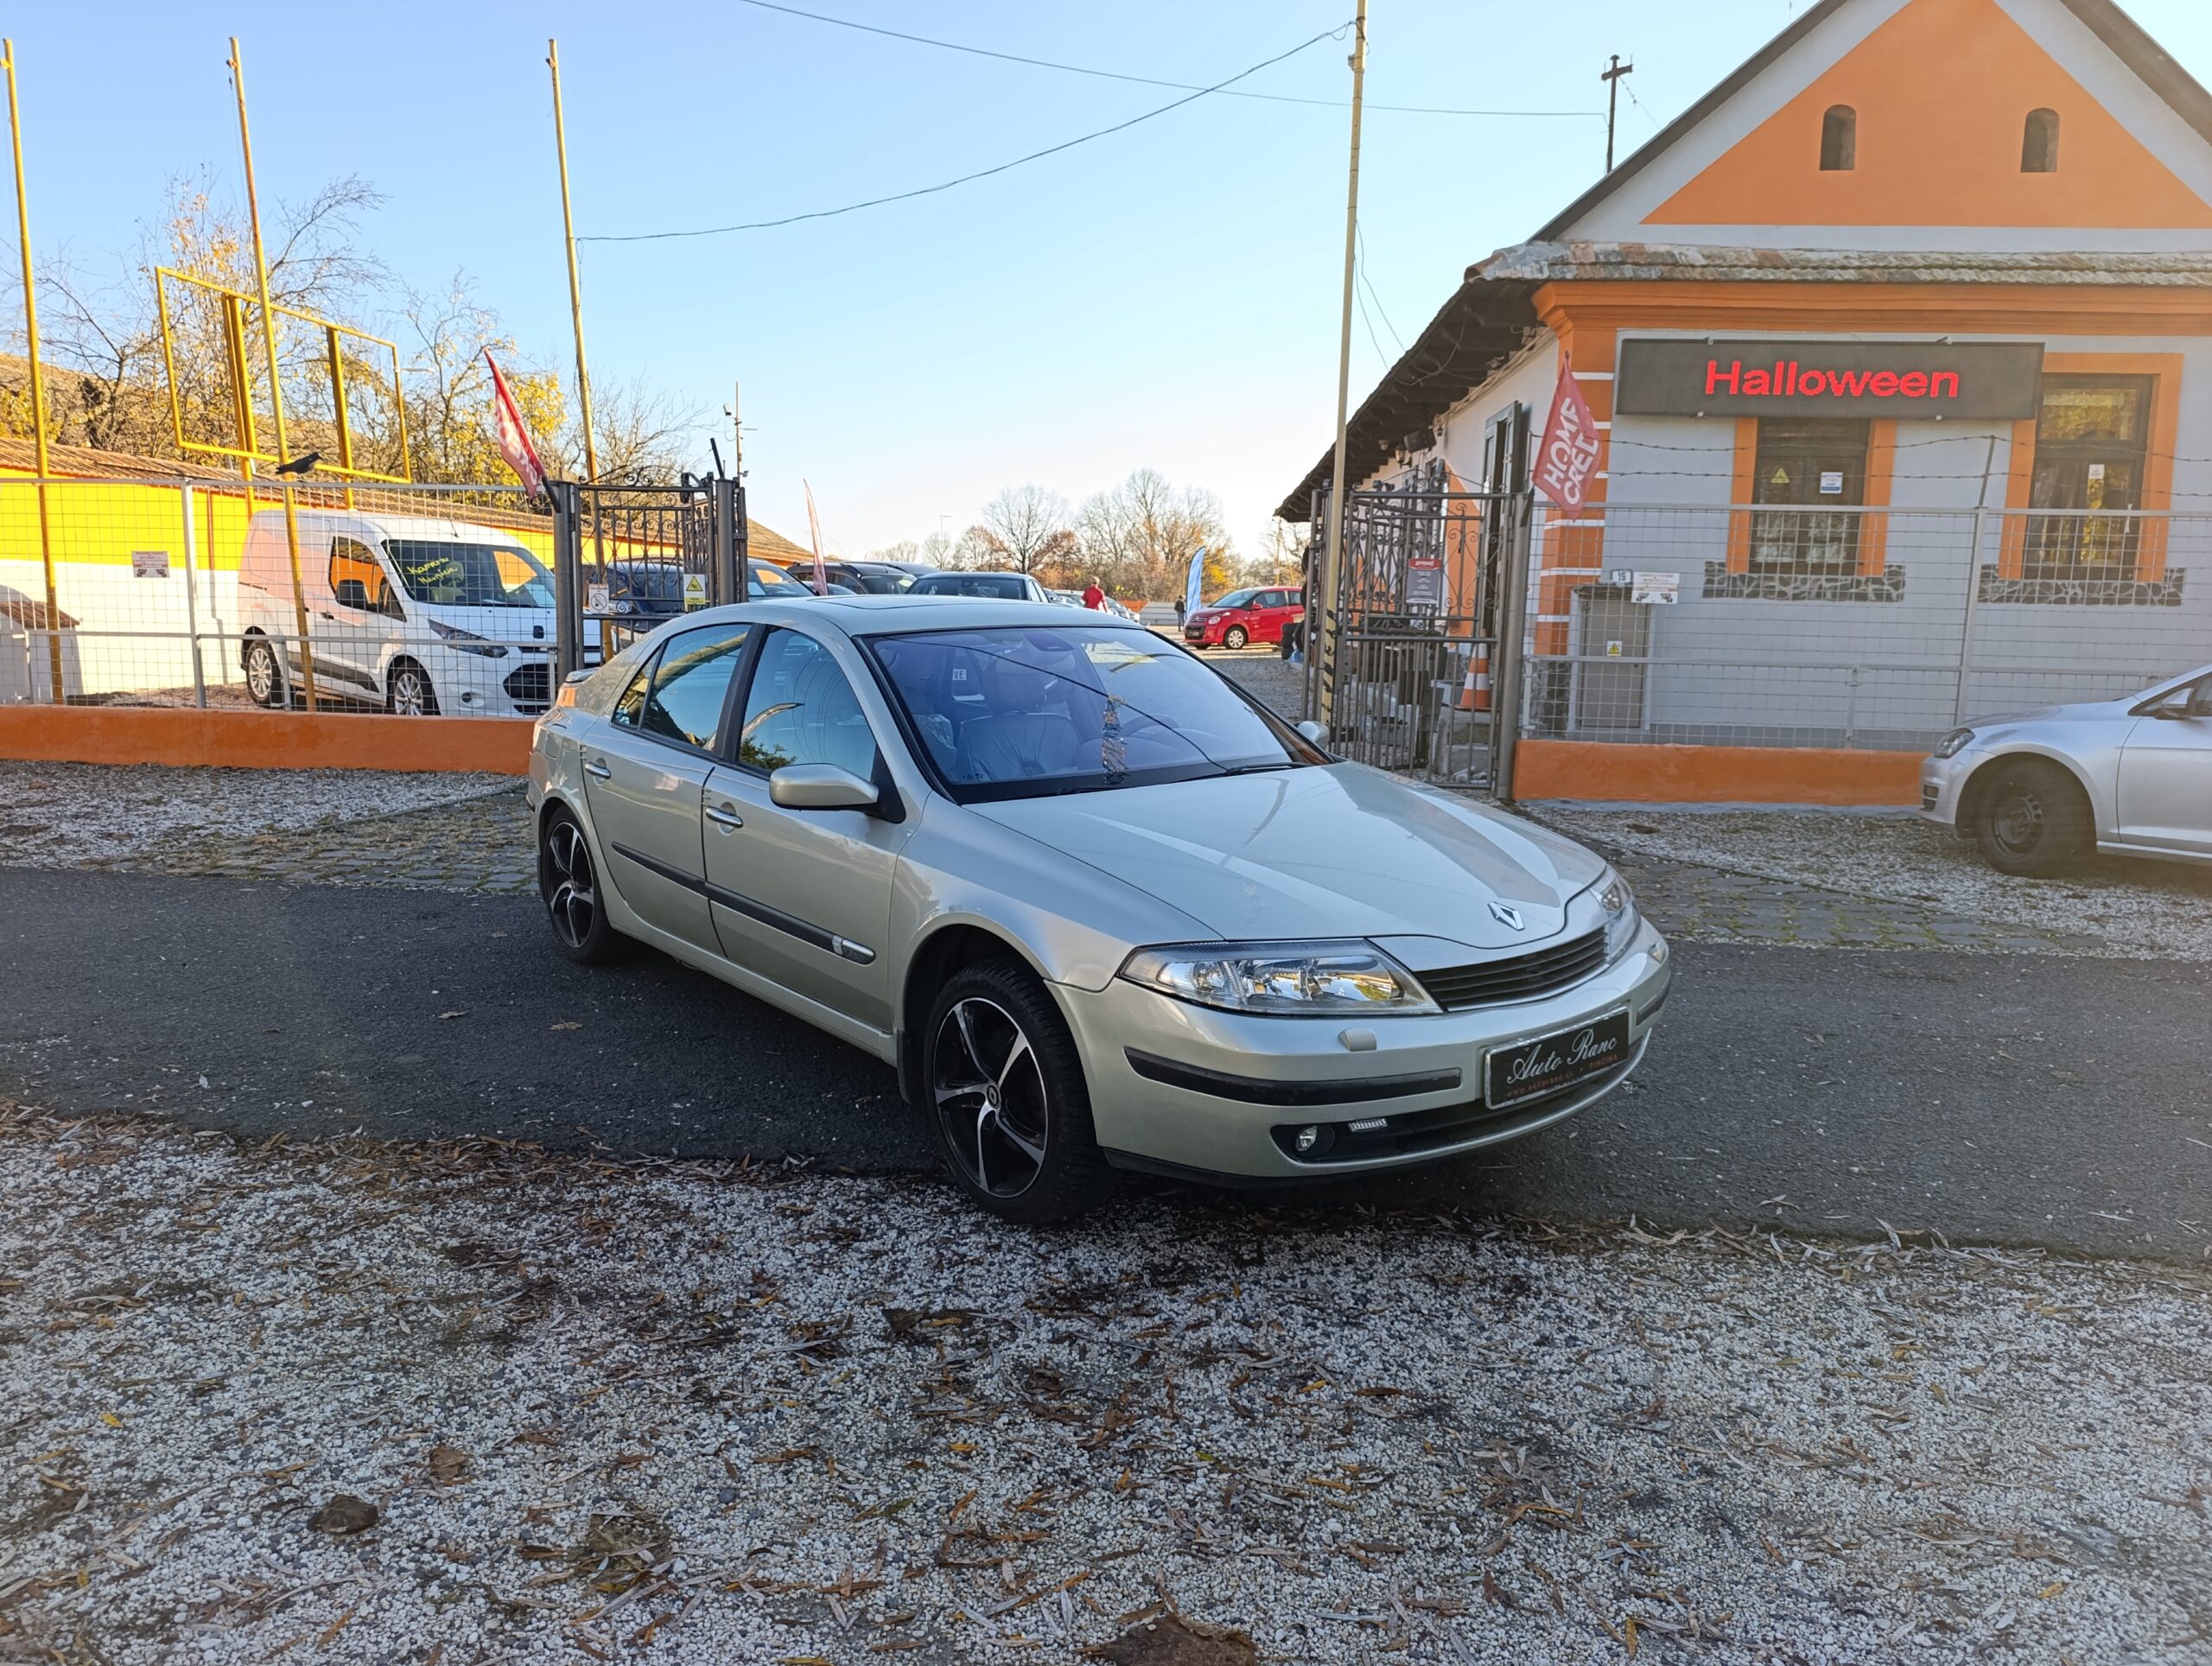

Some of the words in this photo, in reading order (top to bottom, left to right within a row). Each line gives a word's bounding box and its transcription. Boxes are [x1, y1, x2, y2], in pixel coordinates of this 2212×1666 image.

[1705, 359, 1960, 398] Halloween
[1617, 570, 1626, 582] 19
[1507, 1044, 1562, 1084] Auto
[1566, 1027, 1618, 1065] Ranc
